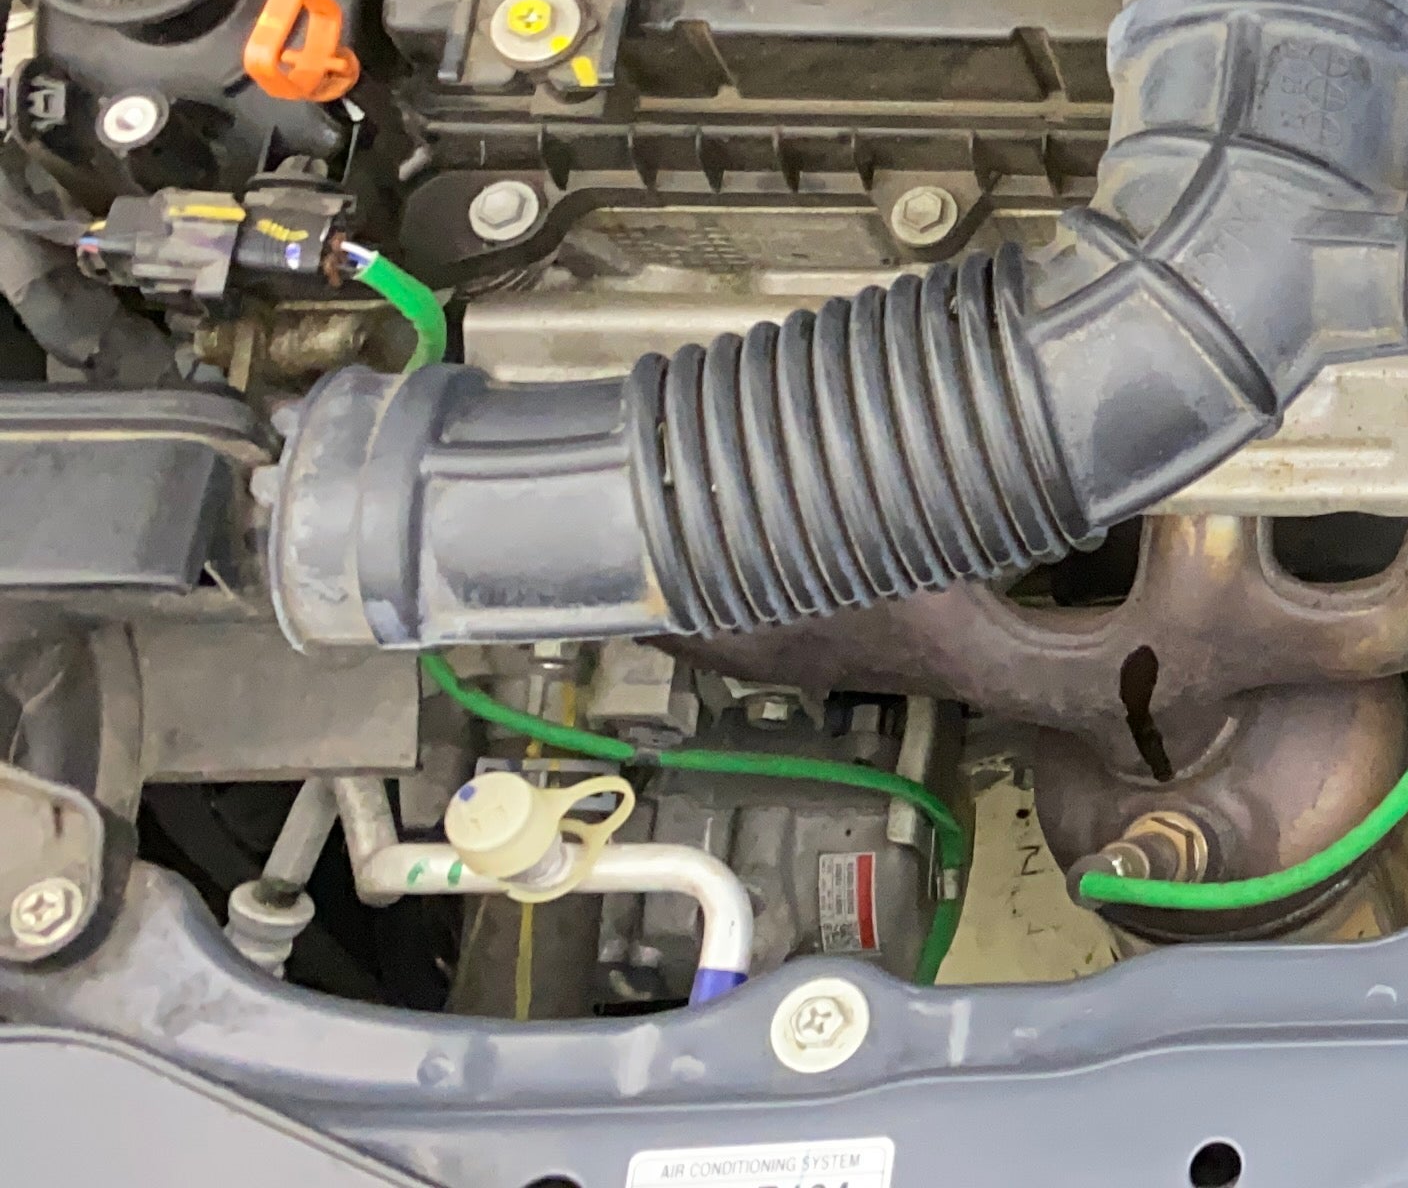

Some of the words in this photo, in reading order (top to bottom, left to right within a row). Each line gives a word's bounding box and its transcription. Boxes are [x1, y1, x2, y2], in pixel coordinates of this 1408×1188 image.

[661, 1164, 685, 1179] AIR
[690, 1157, 796, 1179] CONDITIONING
[802, 1153, 861, 1170] SYSTEM
